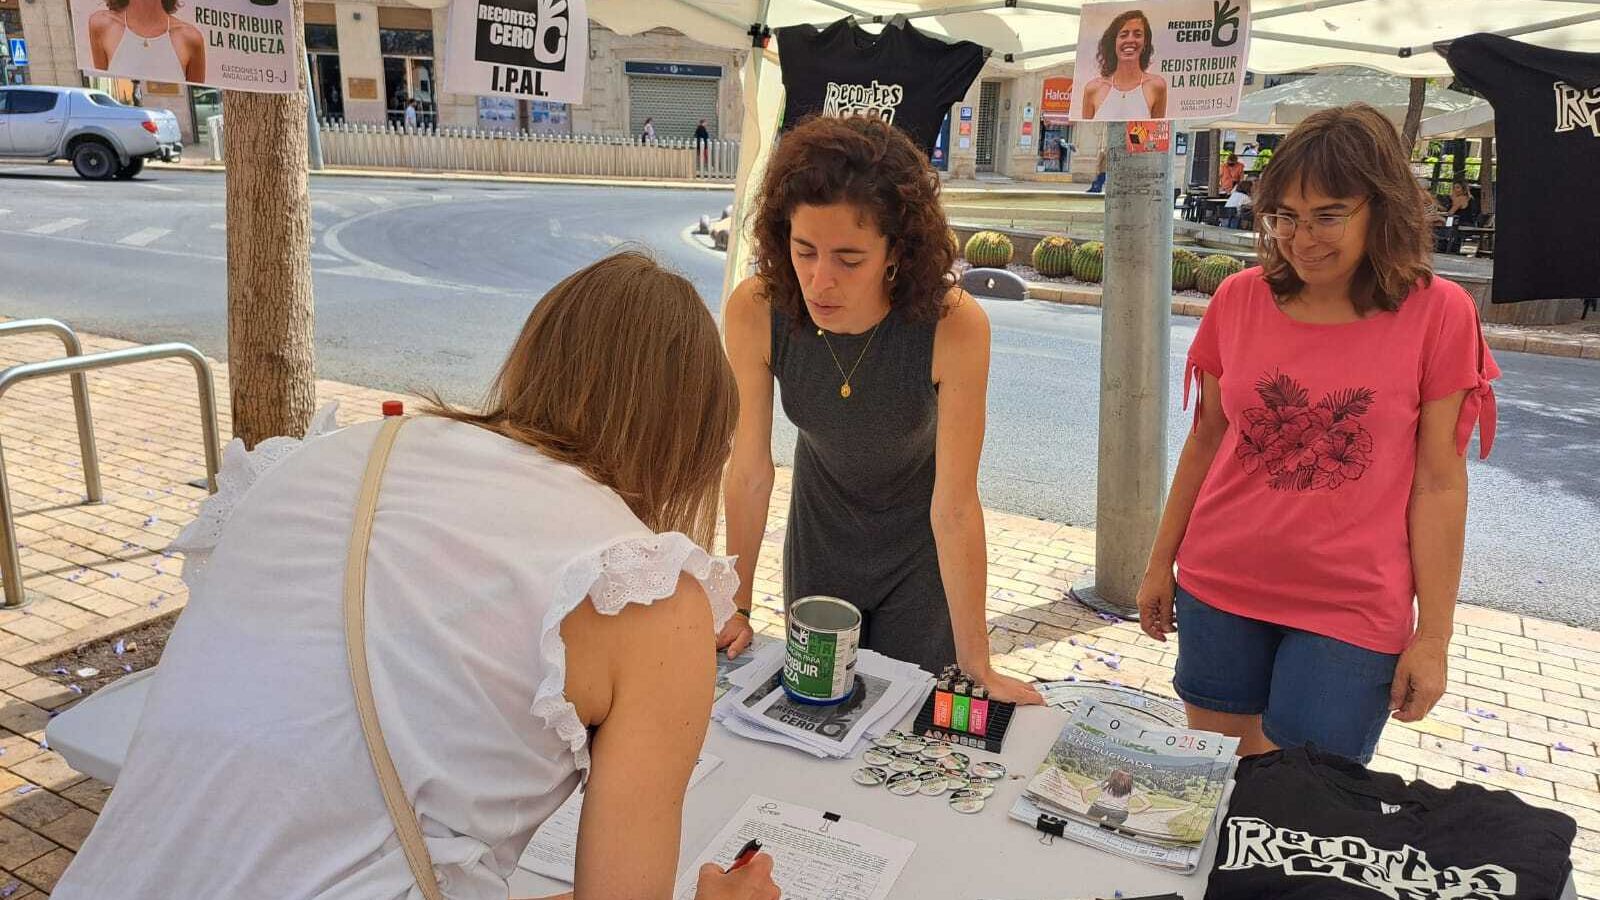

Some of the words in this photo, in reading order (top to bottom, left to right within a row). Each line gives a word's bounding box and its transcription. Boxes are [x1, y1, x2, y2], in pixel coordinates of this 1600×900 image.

[195, 7, 284, 35] REDISTRIBUIR
[479, 4, 537, 28] RECORTES
[1167, 19, 1213, 30] RECORTES
[209, 29, 225, 48] LA
[228, 32, 286, 55] RIQUEZA
[489, 22, 535, 50] CERO
[1176, 28, 1211, 43] CERO
[1161, 55, 1238, 73] REDISTRIBUIR
[259, 68, 288, 84] 19-J
[491, 65, 548, 97] I.P.AL.
[1171, 74, 1185, 88] LA
[1189, 71, 1236, 89] RIQUEZA
[780, 714, 815, 731] CERO
